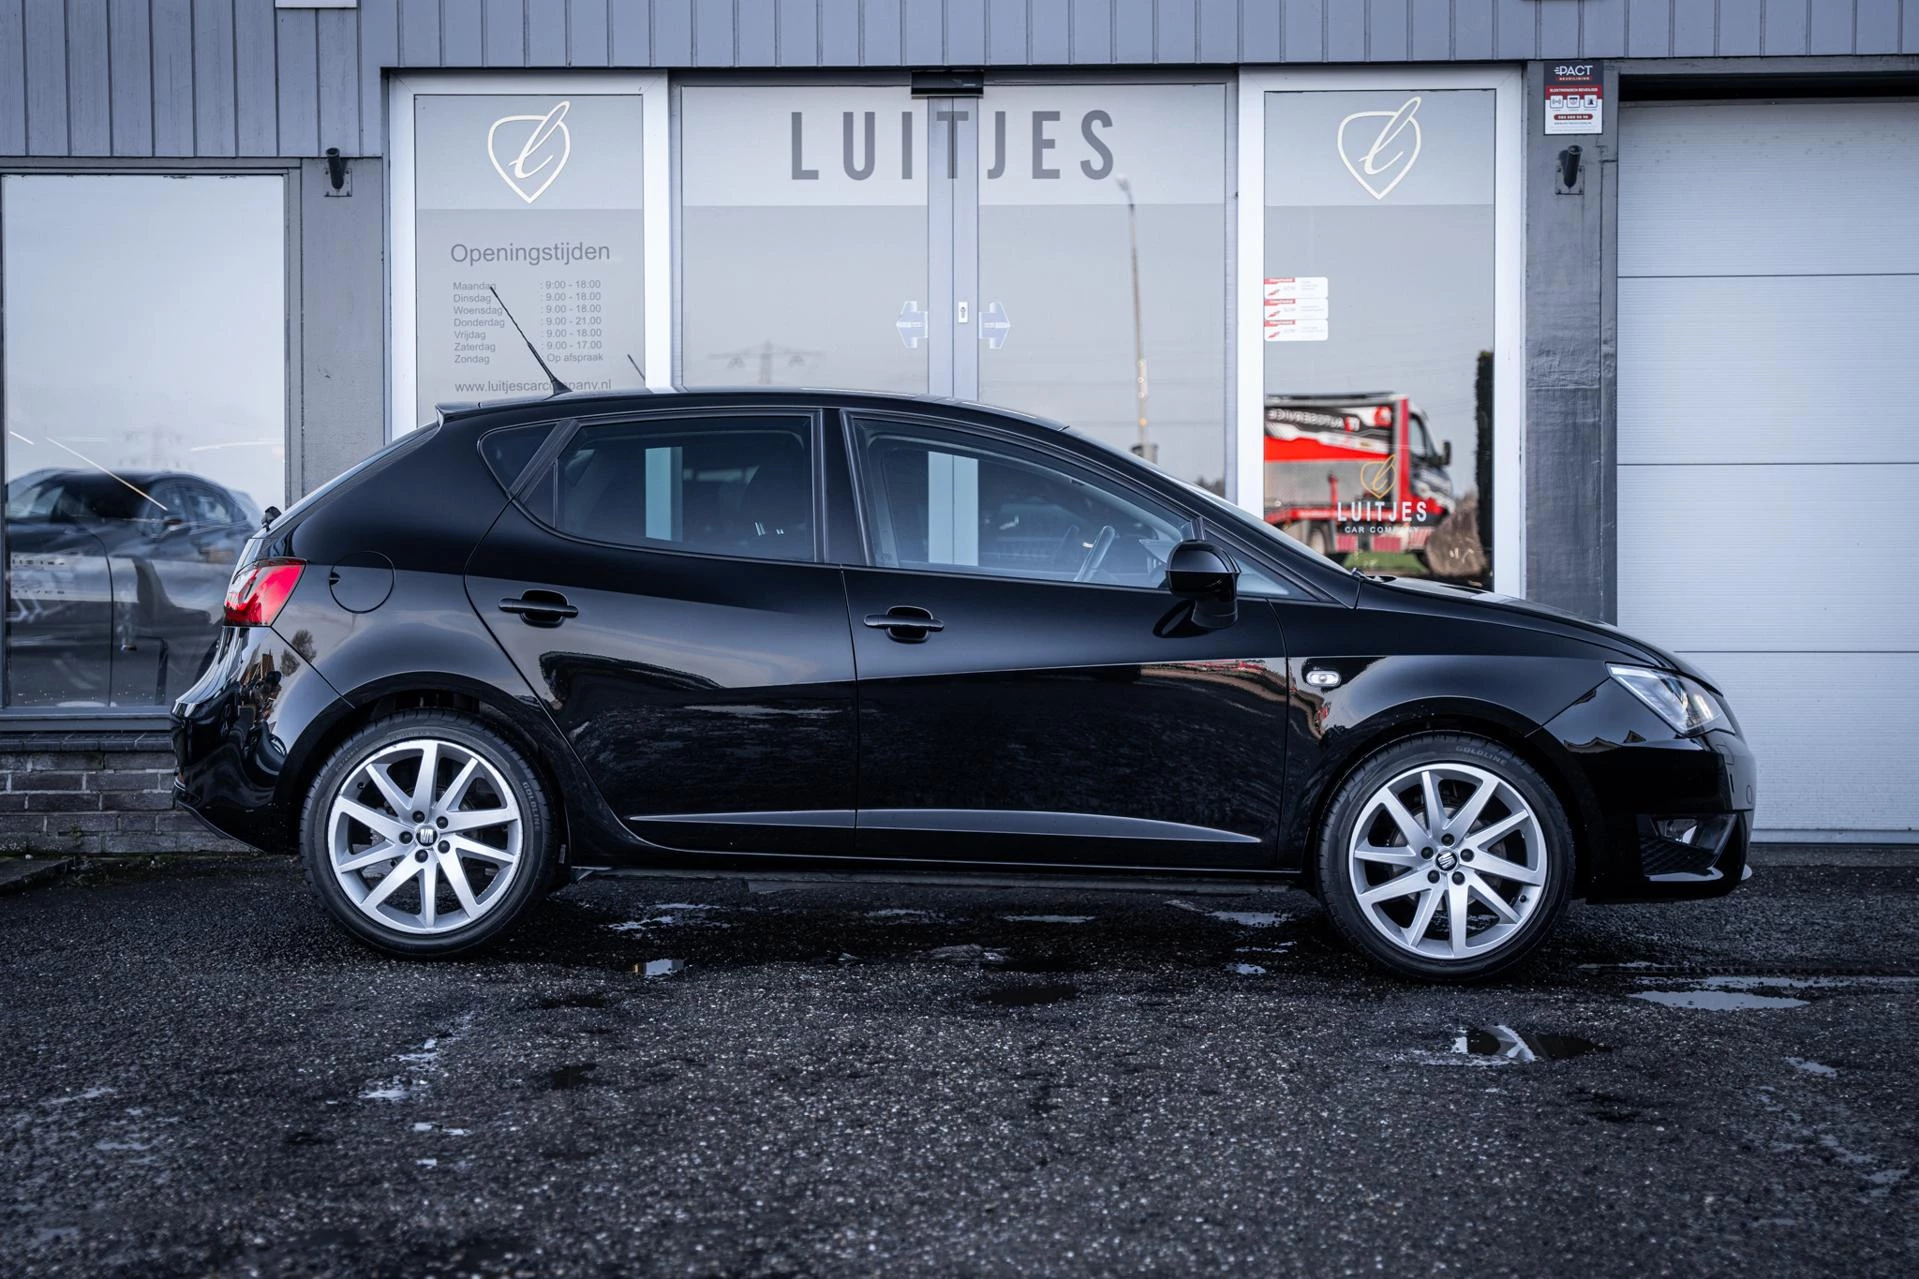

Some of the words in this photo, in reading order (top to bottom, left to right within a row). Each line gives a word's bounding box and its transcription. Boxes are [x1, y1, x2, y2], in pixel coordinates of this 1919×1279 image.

[1558, 65, 1593, 76] PACT
[790, 109, 1114, 180] LUITJES
[450, 242, 610, 266] Openingstijden
[453, 294, 492, 304] Dinsdag
[453, 306, 502, 316] Woensdag
[454, 318, 505, 328] Donderdag
[454, 330, 486, 340] Vrijdag
[454, 342, 496, 353] Zaterdag
[454, 354, 490, 365] Zondag
[546, 353, 561, 363] Op
[563, 352, 604, 364] afspraak
[454, 379, 612, 394] www.luitjescarcpany.nl
[1337, 501, 1427, 522] LUITJES
[1455, 745, 1508, 765] GOLDLINE
[522, 782, 541, 832] GOLDLINE
